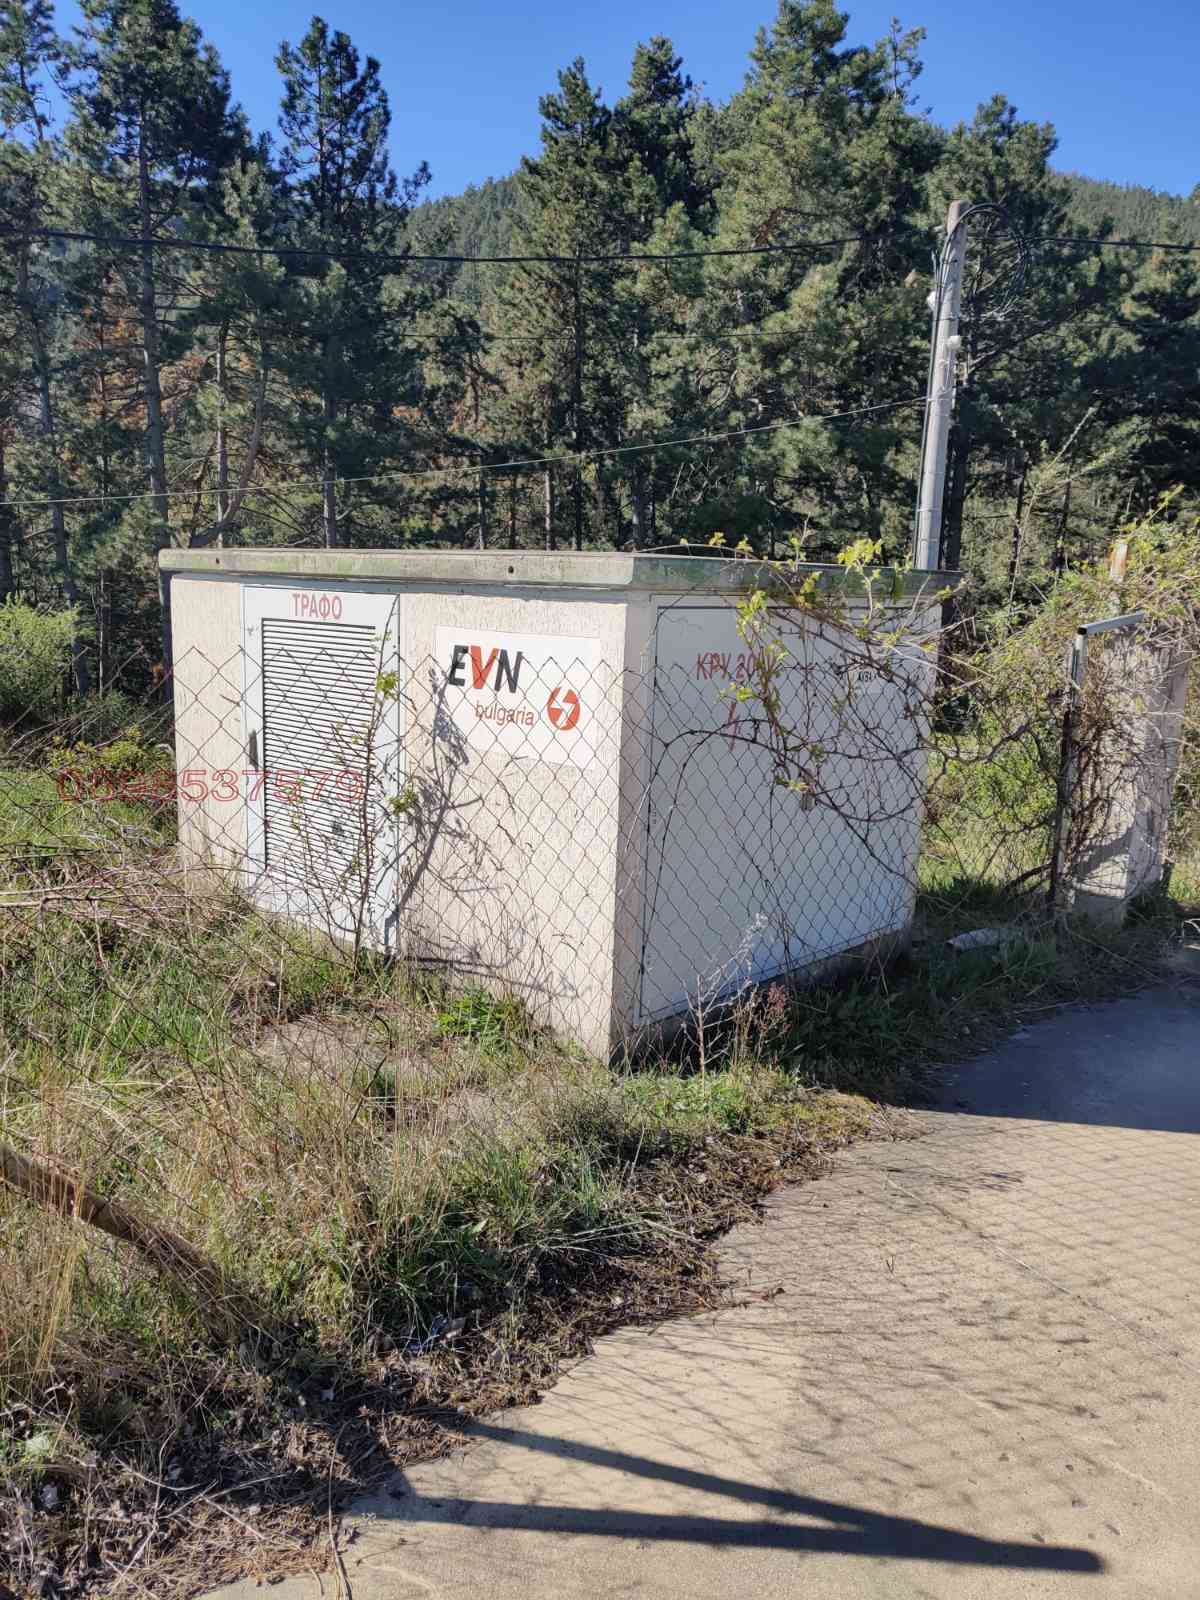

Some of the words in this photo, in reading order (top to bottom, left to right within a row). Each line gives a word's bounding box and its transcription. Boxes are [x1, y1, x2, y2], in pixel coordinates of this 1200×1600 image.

[292, 592, 343, 620] ТРАФО
[447, 644, 523, 694] EVN
[475, 700, 535, 726] bulgaria
